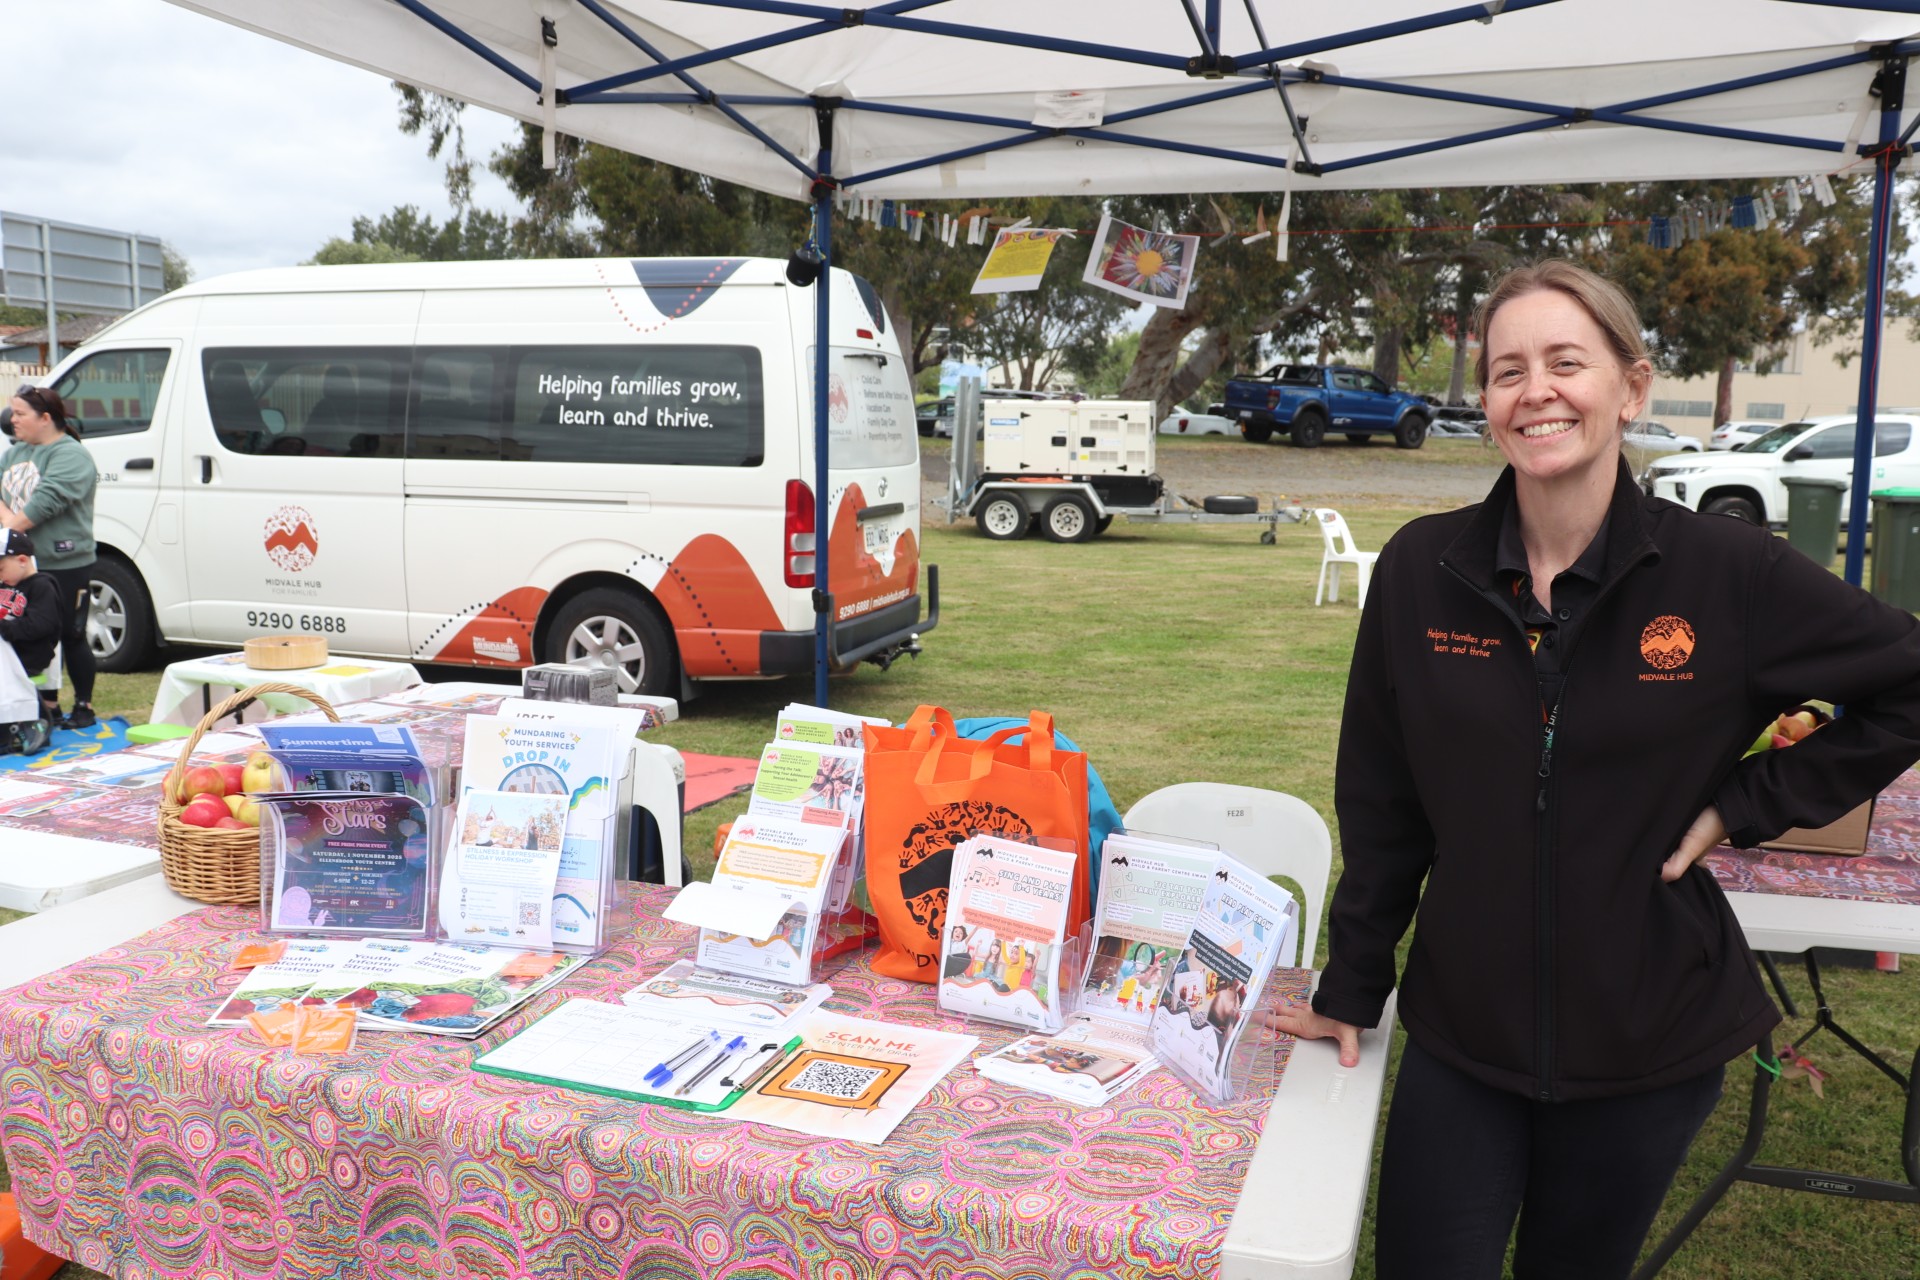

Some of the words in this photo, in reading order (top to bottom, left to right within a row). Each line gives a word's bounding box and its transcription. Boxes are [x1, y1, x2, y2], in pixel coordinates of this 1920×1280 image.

[538, 375, 603, 400] Helping
[610, 375, 682, 396] families
[690, 380, 741, 402] grow,
[559, 406, 605, 425] learn
[613, 407, 648, 426] and
[656, 408, 714, 429] thrive.
[265, 579, 301, 588] MIDVALE
[247, 611, 293, 630] 9290
[300, 615, 346, 633] 6888
[1427, 628, 1448, 641] Helping
[1451, 630, 1478, 643] families
[1434, 642, 1449, 652] learn
[1452, 644, 1467, 654] and
[1469, 646, 1491, 657] thrive
[1639, 673, 1675, 681] MIDVALE
[1677, 672, 1694, 680] HUB
[514, 729, 565, 739] MUNDARING
[281, 738, 374, 747] Summertime
[504, 739, 533, 747] YOUTH
[535, 741, 576, 750] SERVICES
[502, 750, 549, 768] DROP
[554, 756, 571, 773] IN
[323, 803, 387, 835] Stars
[1227, 809, 1245, 818] FE28
[757, 831, 786, 840] PARENTING
[507, 850, 548, 859] EXPRESSION
[1015, 859, 1034, 867] PARENT
[1035, 864, 1053, 872] CENTRE
[998, 869, 1020, 881] SING
[1021, 875, 1041, 886] AND
[1043, 880, 1067, 892] PLAY
[1154, 880, 1167, 889] TIC
[1169, 882, 1185, 892] TAT
[1013, 883, 1031, 894] (0-4
[1032, 887, 1064, 902] YEARS)
[1133, 885, 1158, 896] EARLY
[1176, 900, 1201, 912] YEAR
[1221, 892, 1238, 909] READ
[1236, 902, 1254, 919] PLAY
[1252, 913, 1274, 931] GROW
[1106, 921, 1123, 929] Connect
[1133, 926, 1146, 934] others
[1162, 931, 1172, 939] child
[355, 953, 392, 961] Youth
[433, 952, 466, 961] Youth
[263, 965, 323, 973] Strategy
[272, 960, 335, 968] nforming
[414, 960, 468, 974] Strategy
[825, 1031, 881, 1046] SCAN
[885, 1040, 917, 1052] ME
[831, 1040, 865, 1049] ENTER
[866, 1045, 886, 1053] THE
[887, 1049, 920, 1058] DRAW
[1811, 1180, 1849, 1190] LIFETIME
